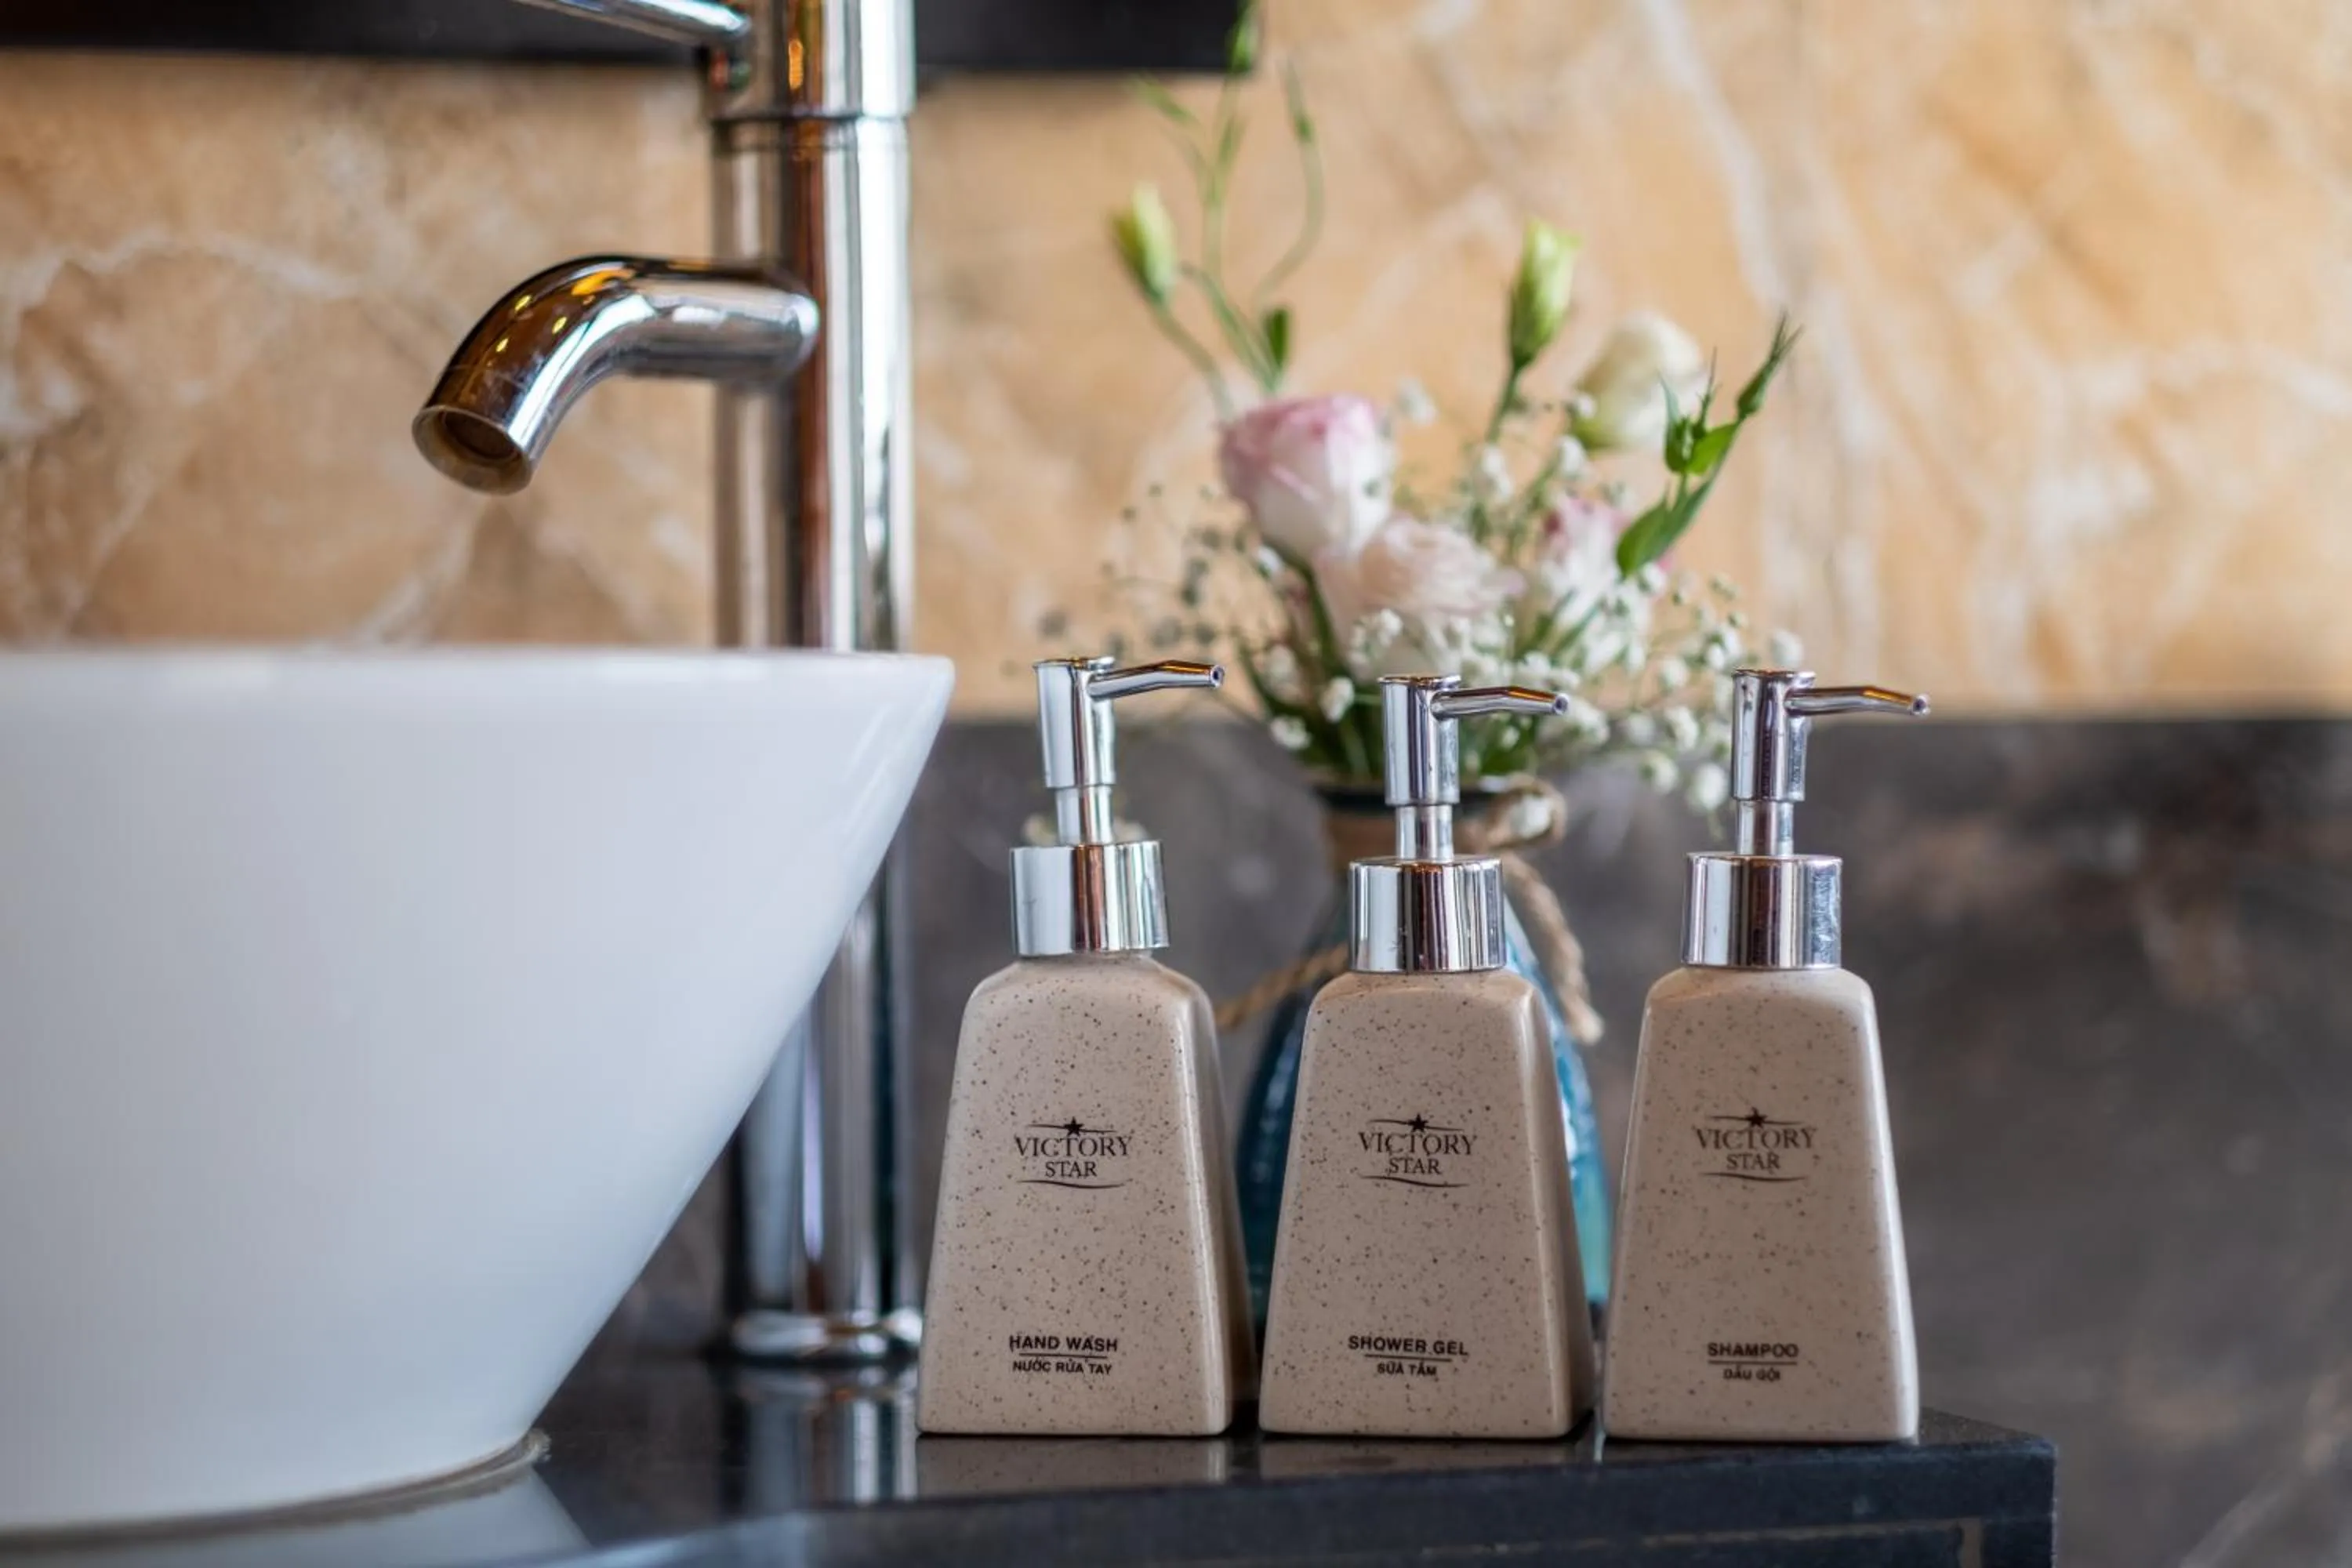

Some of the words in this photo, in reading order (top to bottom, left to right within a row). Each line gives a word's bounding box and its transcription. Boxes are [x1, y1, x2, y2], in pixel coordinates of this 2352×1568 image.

[1014, 1135, 1131, 1156] VICTORY
[1359, 1132, 1476, 1155] VICTORY
[1693, 1127, 1817, 1149] VICTORY
[1045, 1161, 1098, 1178] STAR
[1388, 1157, 1441, 1174] STAR
[1726, 1153, 1780, 1170] STAR
[1009, 1335, 1059, 1350] HAND
[1066, 1336, 1117, 1352] WASH
[1348, 1335, 1427, 1352] SHOWER
[1433, 1340, 1468, 1356] GEL
[1708, 1342, 1799, 1357] SHAMPOO
[1088, 1363, 1112, 1374] TAY
